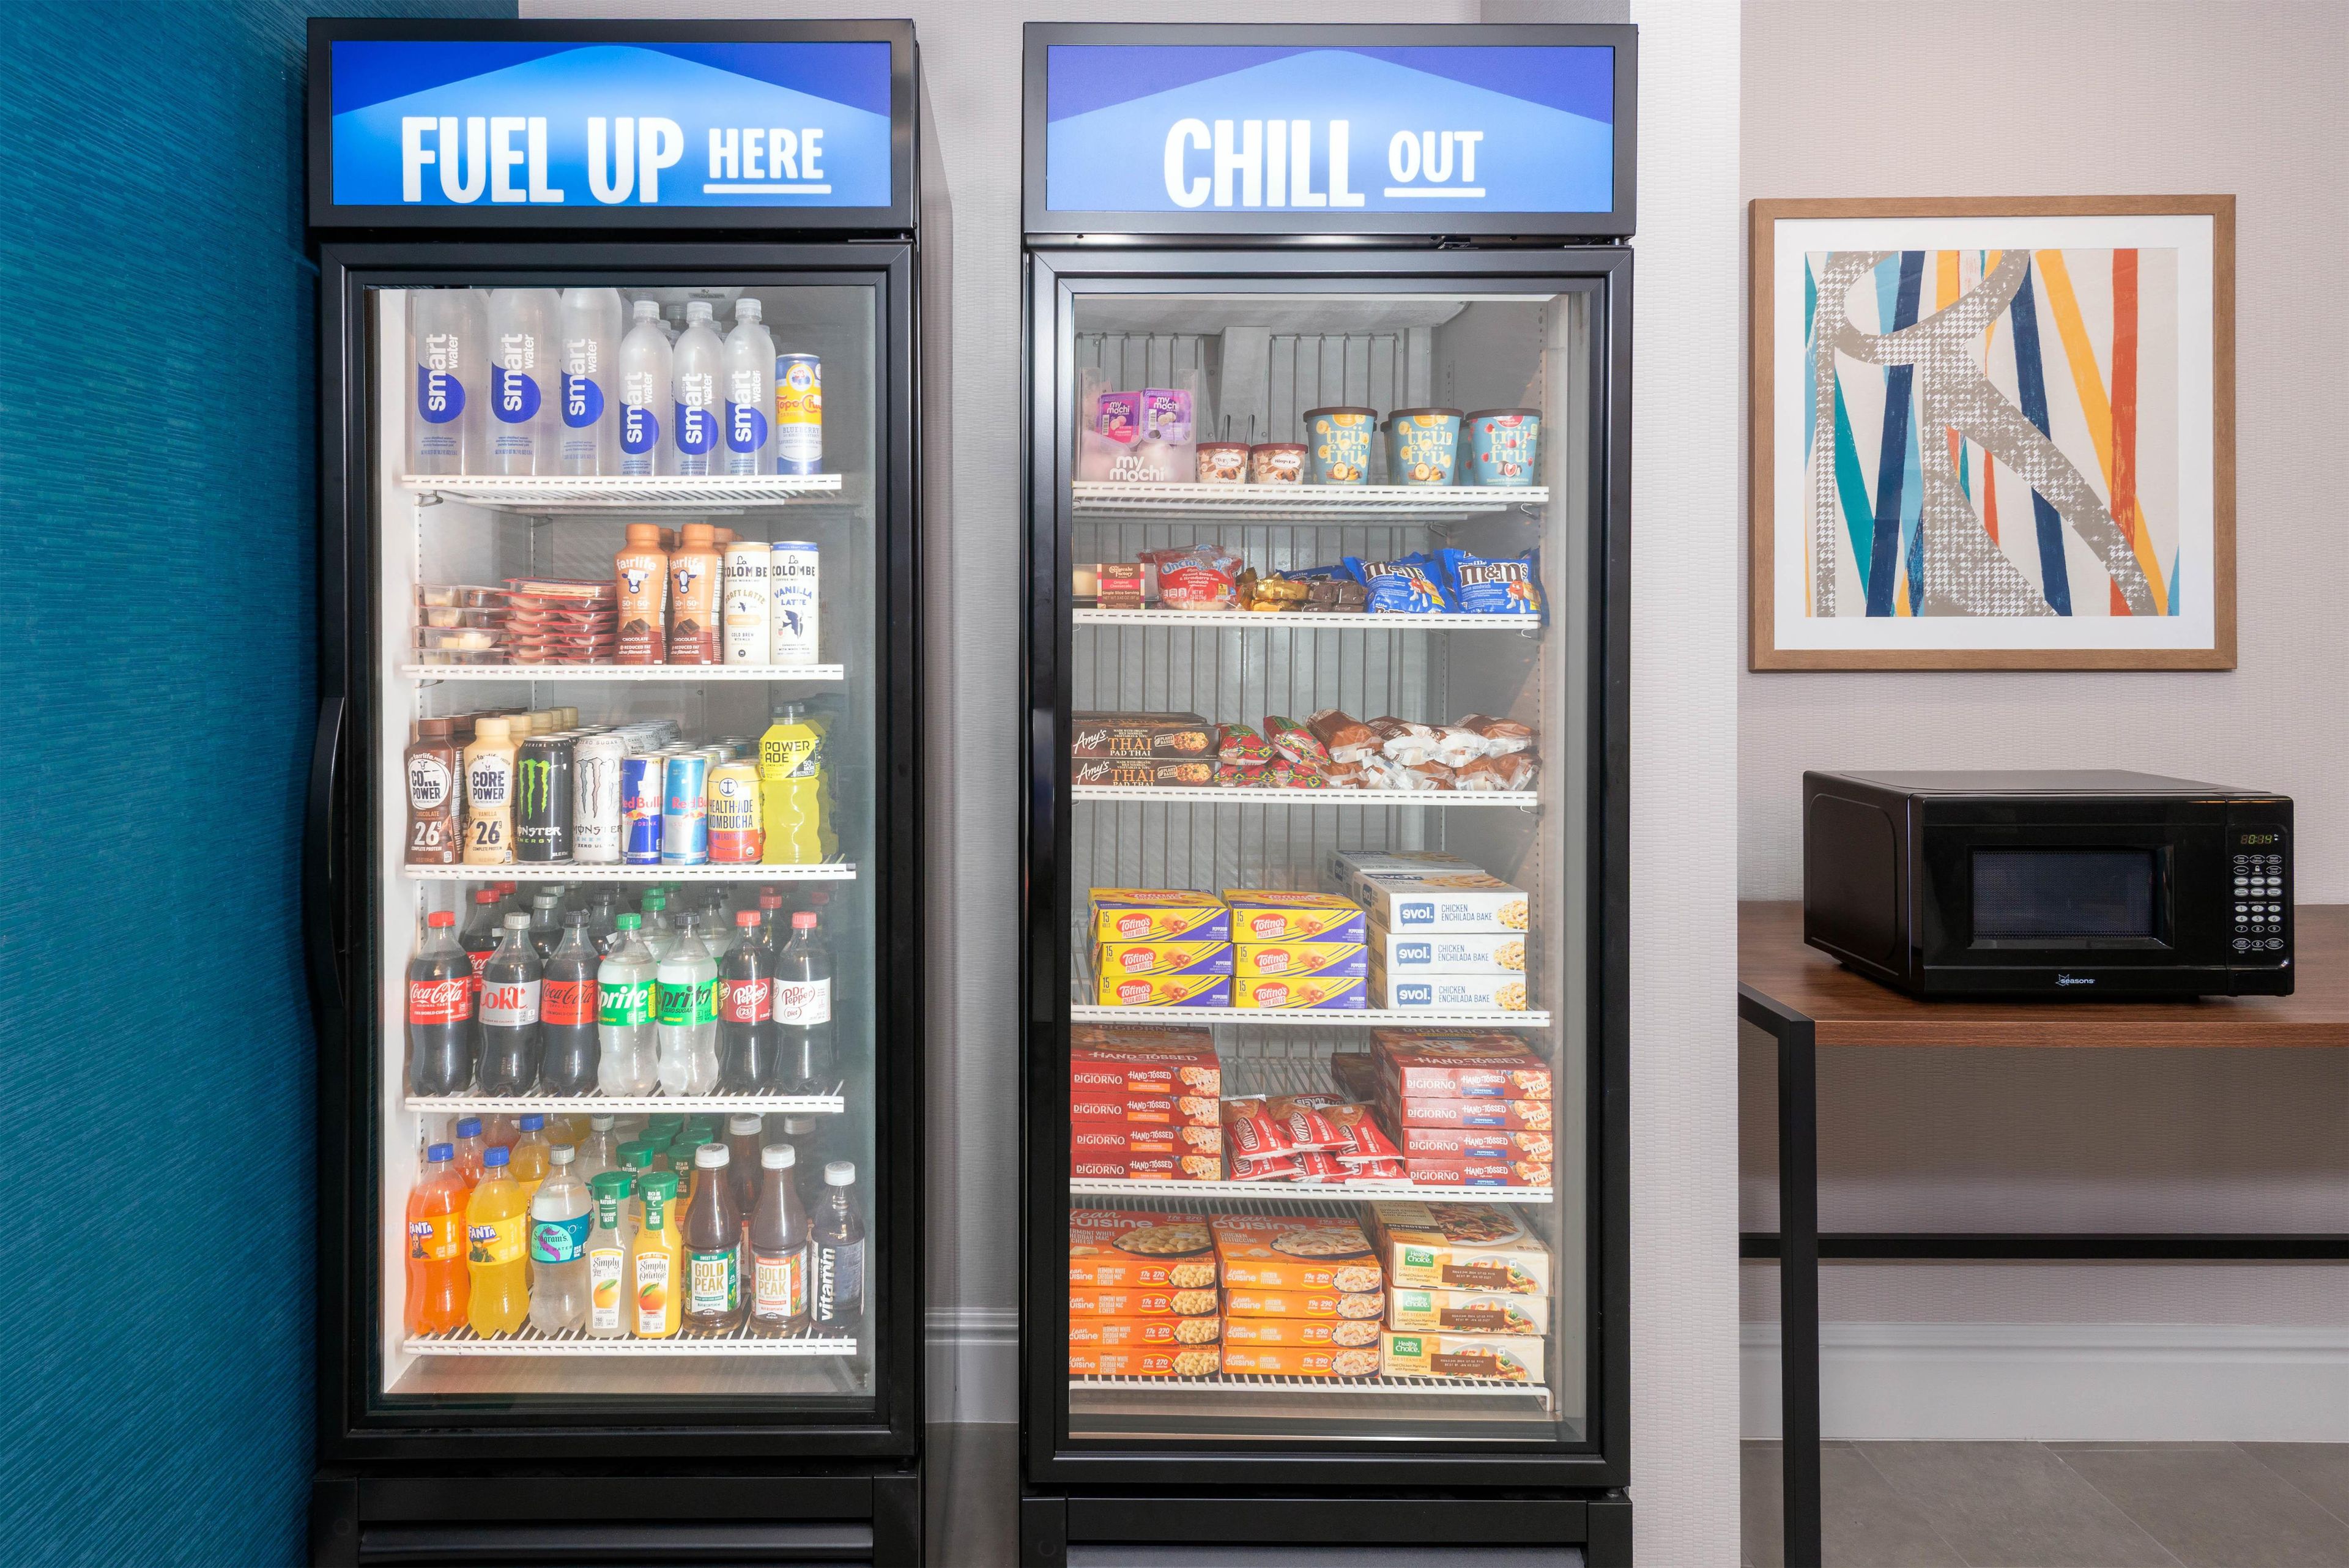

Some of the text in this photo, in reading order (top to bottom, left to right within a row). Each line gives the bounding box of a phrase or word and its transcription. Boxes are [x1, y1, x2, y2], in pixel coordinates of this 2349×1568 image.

[403, 116, 824, 204] FUEL UP HERE
[1164, 117, 1484, 208] CHILL OUT
[447, 334, 458, 368] water
[523, 335, 533, 368] water
[587, 339, 597, 373] water
[426, 334, 446, 411] smart
[501, 334, 522, 411] smart
[568, 338, 585, 415] smart
[625, 372, 642, 444] smart
[682, 373, 702, 444] smart
[733, 370, 751, 442] smart
[1107, 406, 1130, 414] mochi
[1110, 401, 1122, 411] my
[1116, 456, 1145, 470] my
[1110, 467, 1165, 482] mochi
[737, 555, 747, 565] La
[789, 555, 798, 564] La
[765, 741, 810, 752] POWER
[1073, 729, 1107, 754] Amy's
[1108, 738, 1152, 750] THAI
[765, 753, 789, 763] ADE
[473, 771, 505, 787] CORE
[1076, 761, 1110, 785] Amy's
[1111, 769, 1155, 782] THAI
[413, 787, 440, 799] POWER
[473, 788, 504, 800] POWER
[710, 800, 753, 813] HEALTH-ADE
[709, 815, 753, 828] KOMBUCHA
[1102, 912, 1110, 922] 15
[1236, 912, 1244, 921] 15
[1403, 908, 1433, 920] evol.
[1441, 913, 1475, 921] ENCHILADA
[1119, 918, 1150, 931] Totino's
[1254, 918, 1285, 931] Totino's
[1106, 946, 1113, 957] 15
[1399, 948, 1430, 959] evol.
[1123, 953, 1154, 965] Totino's
[1257, 953, 1288, 965] Totino's
[1102, 978, 1110, 988] 15
[411, 980, 464, 1004] Coca-Cola
[543, 983, 593, 1005] Coca-Cola
[737, 987, 765, 1005] Pepper
[1119, 984, 1150, 997] Totino's
[1256, 987, 1286, 1000] Totino's
[1399, 989, 1430, 1000] evol.
[1439, 986, 1465, 994] CHICKEN
[598, 984, 648, 1011] Sprite
[785, 989, 812, 1005] Pepper
[1474, 994, 1490, 1003] BAKE
[1128, 1071, 1171, 1080] HAND-TOSSED
[1461, 1076, 1505, 1084] HAND-TOSSED
[1127, 1101, 1170, 1110] HAND-TOSSED
[1462, 1104, 1506, 1113] HAND-TOSSED
[1130, 1131, 1174, 1140] HAND-TOSSED
[1463, 1137, 1508, 1146] HAND-TOSSED
[1129, 1161, 1173, 1170] HAND-TOSSED
[1464, 1166, 1508, 1175] HAND-TOSSED
[410, 1221, 433, 1234] FANTA
[469, 1225, 495, 1239] FANTA
[593, 1257, 619, 1269] Simply
[640, 1260, 666, 1272] Simply
[640, 1272, 666, 1281] Orange
[695, 1263, 724, 1277] GOLD
[759, 1267, 786, 1282] GOLD
[695, 1277, 724, 1291] PEAK
[759, 1282, 786, 1295] PEAK
[819, 1248, 836, 1321] vitamin
